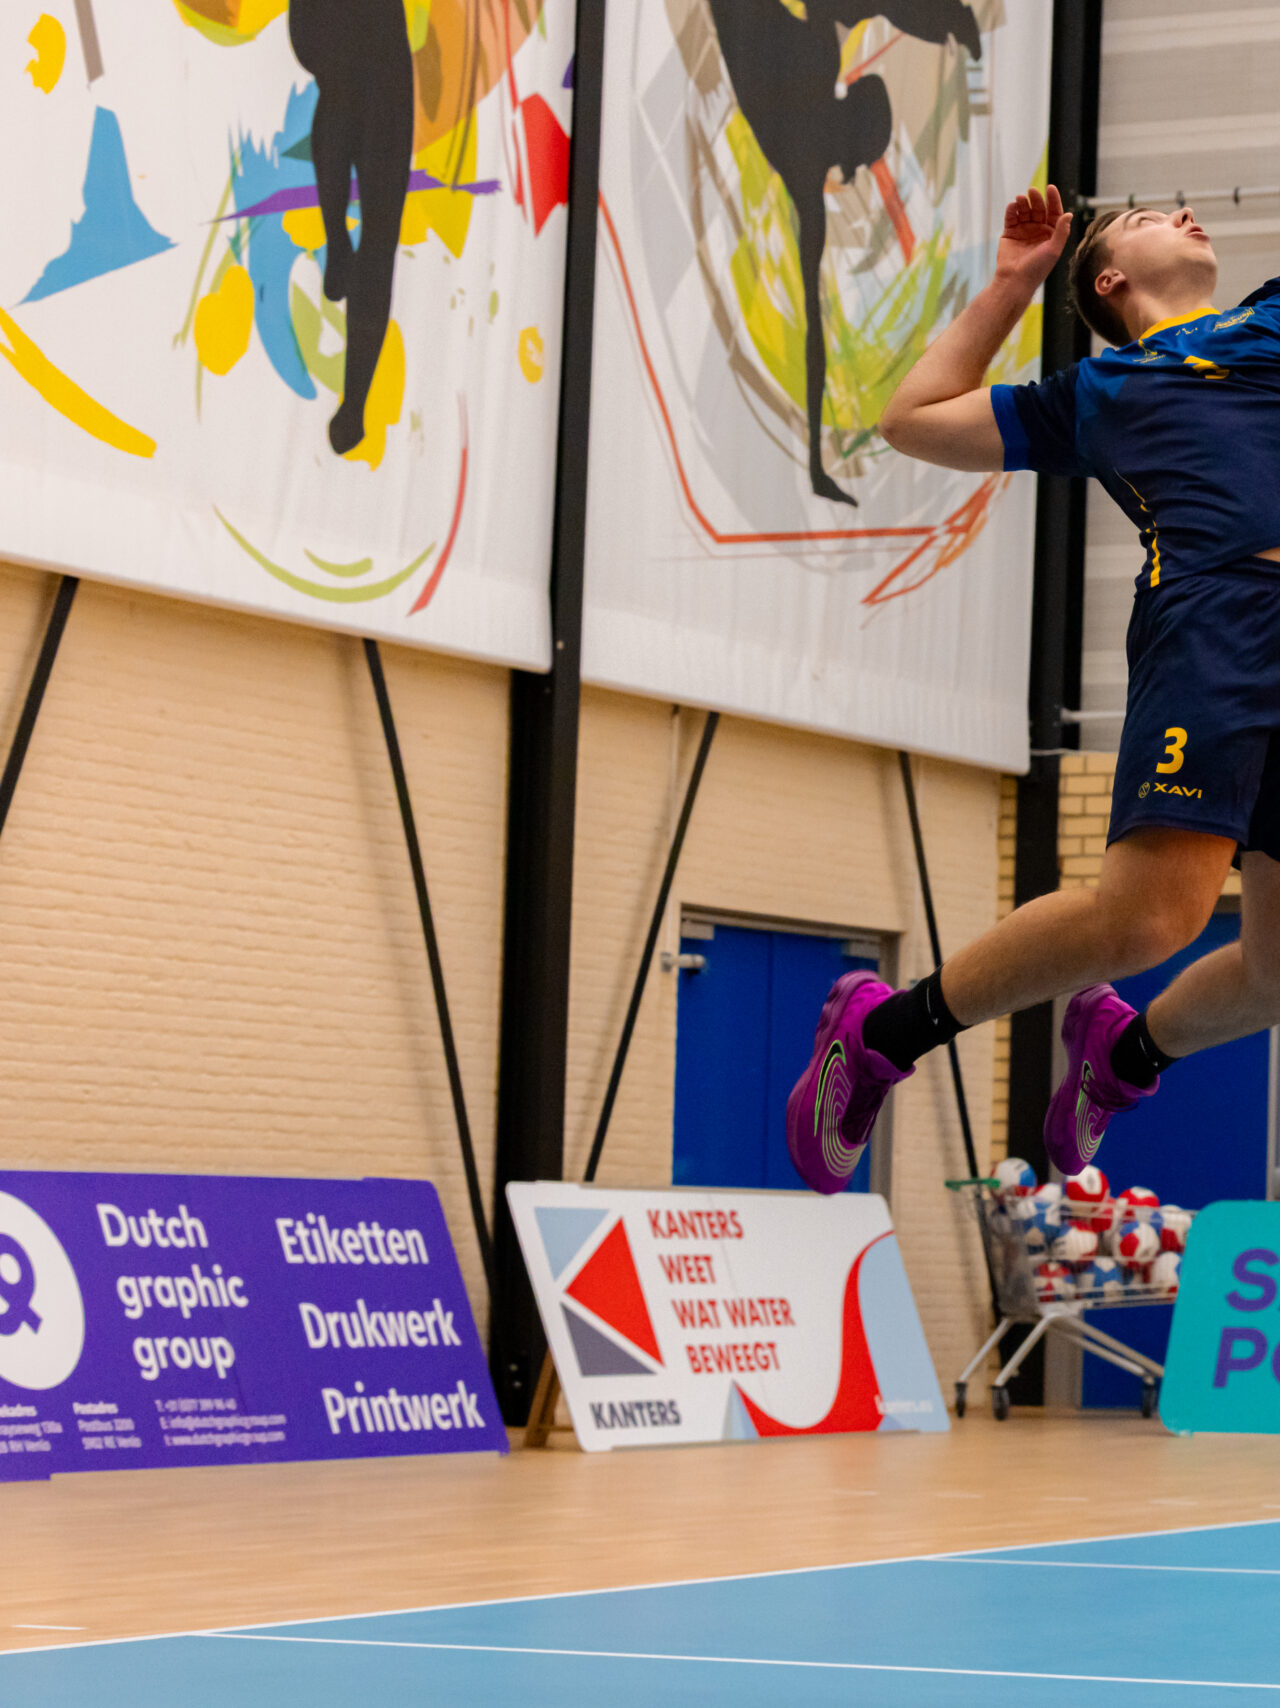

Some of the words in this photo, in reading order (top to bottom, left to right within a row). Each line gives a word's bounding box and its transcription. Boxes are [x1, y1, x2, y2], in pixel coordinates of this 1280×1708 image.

[1156, 726, 1188, 774] 3
[1153, 782, 1203, 799] XAVI
[96, 1203, 209, 1248] Dutch
[275, 1212, 430, 1265] Etiketten
[646, 1209, 744, 1240] KANTERS
[116, 1263, 249, 1319] graphic
[658, 1255, 717, 1285] WEET
[298, 1298, 462, 1349] Drukwerk
[671, 1299, 721, 1329] WAT
[722, 1298, 796, 1329] WATER
[133, 1335, 236, 1380] group
[685, 1342, 781, 1374] BEWEEGT
[321, 1380, 487, 1434] Printwerk
[589, 1399, 682, 1429] KANTERS
